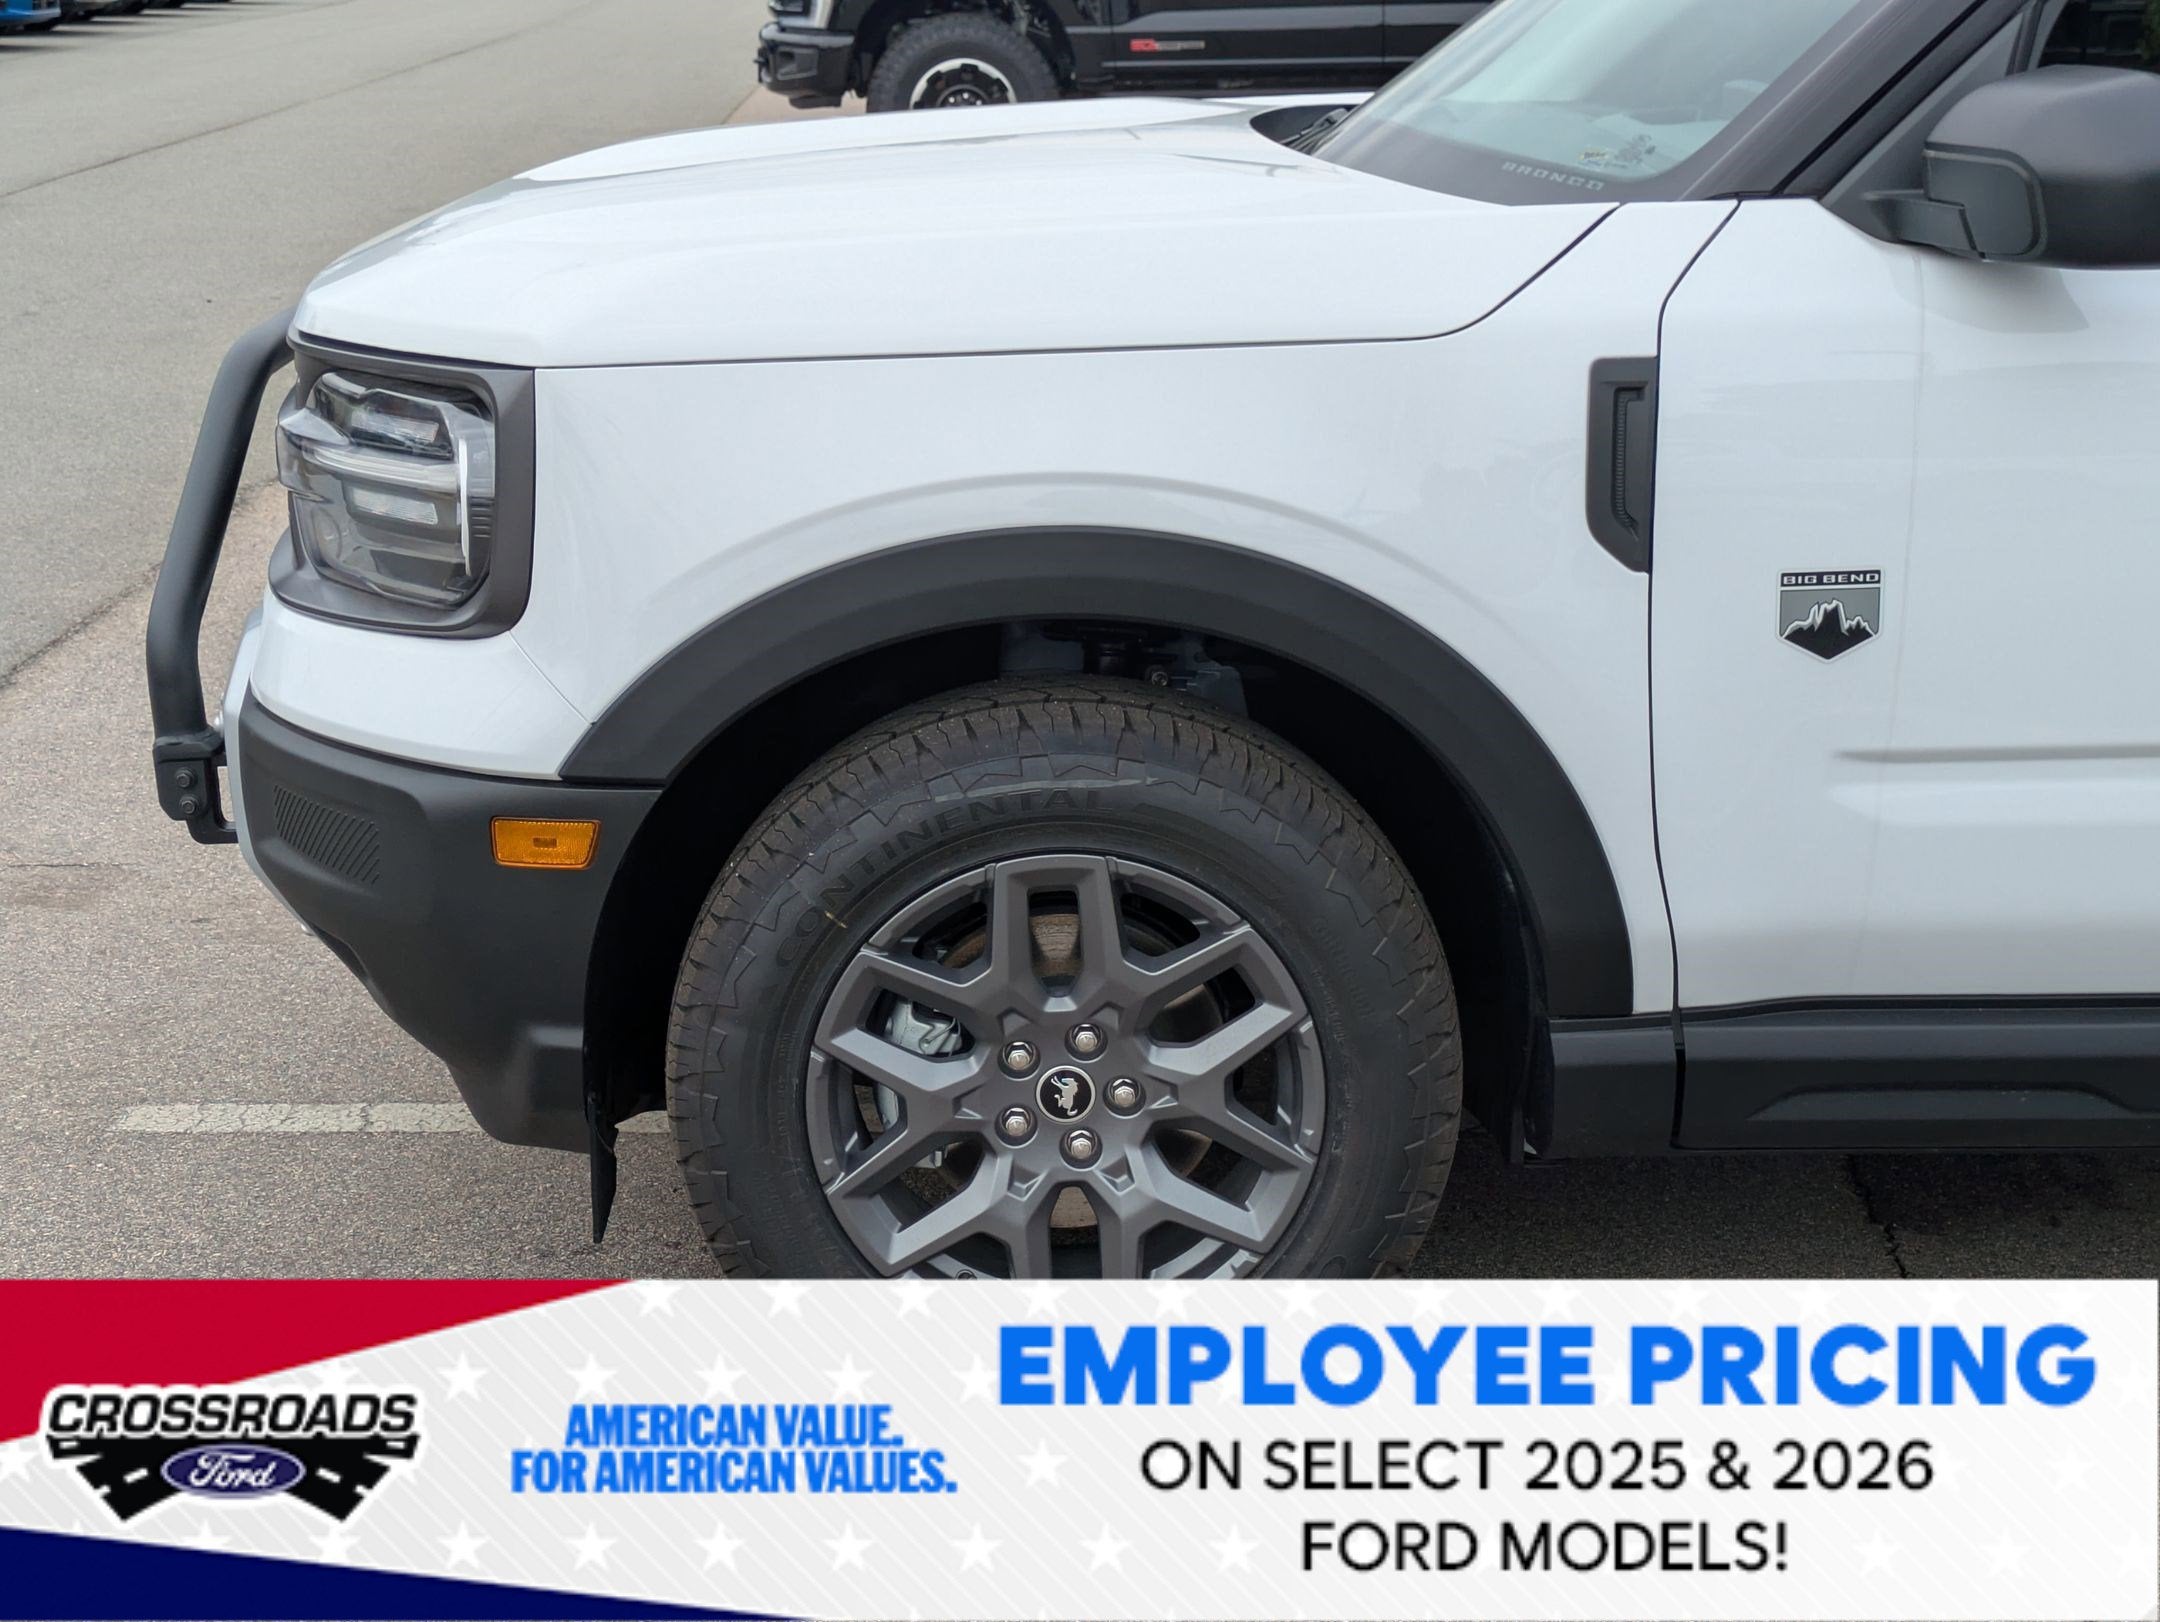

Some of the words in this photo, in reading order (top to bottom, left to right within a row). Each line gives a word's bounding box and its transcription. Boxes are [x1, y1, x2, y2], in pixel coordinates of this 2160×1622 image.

[1501, 161, 1605, 191] BRONCO
[1783, 575, 1817, 585] BIG
[1823, 573, 1880, 584] BEND
[775, 786, 1115, 968] CONTINENTAL
